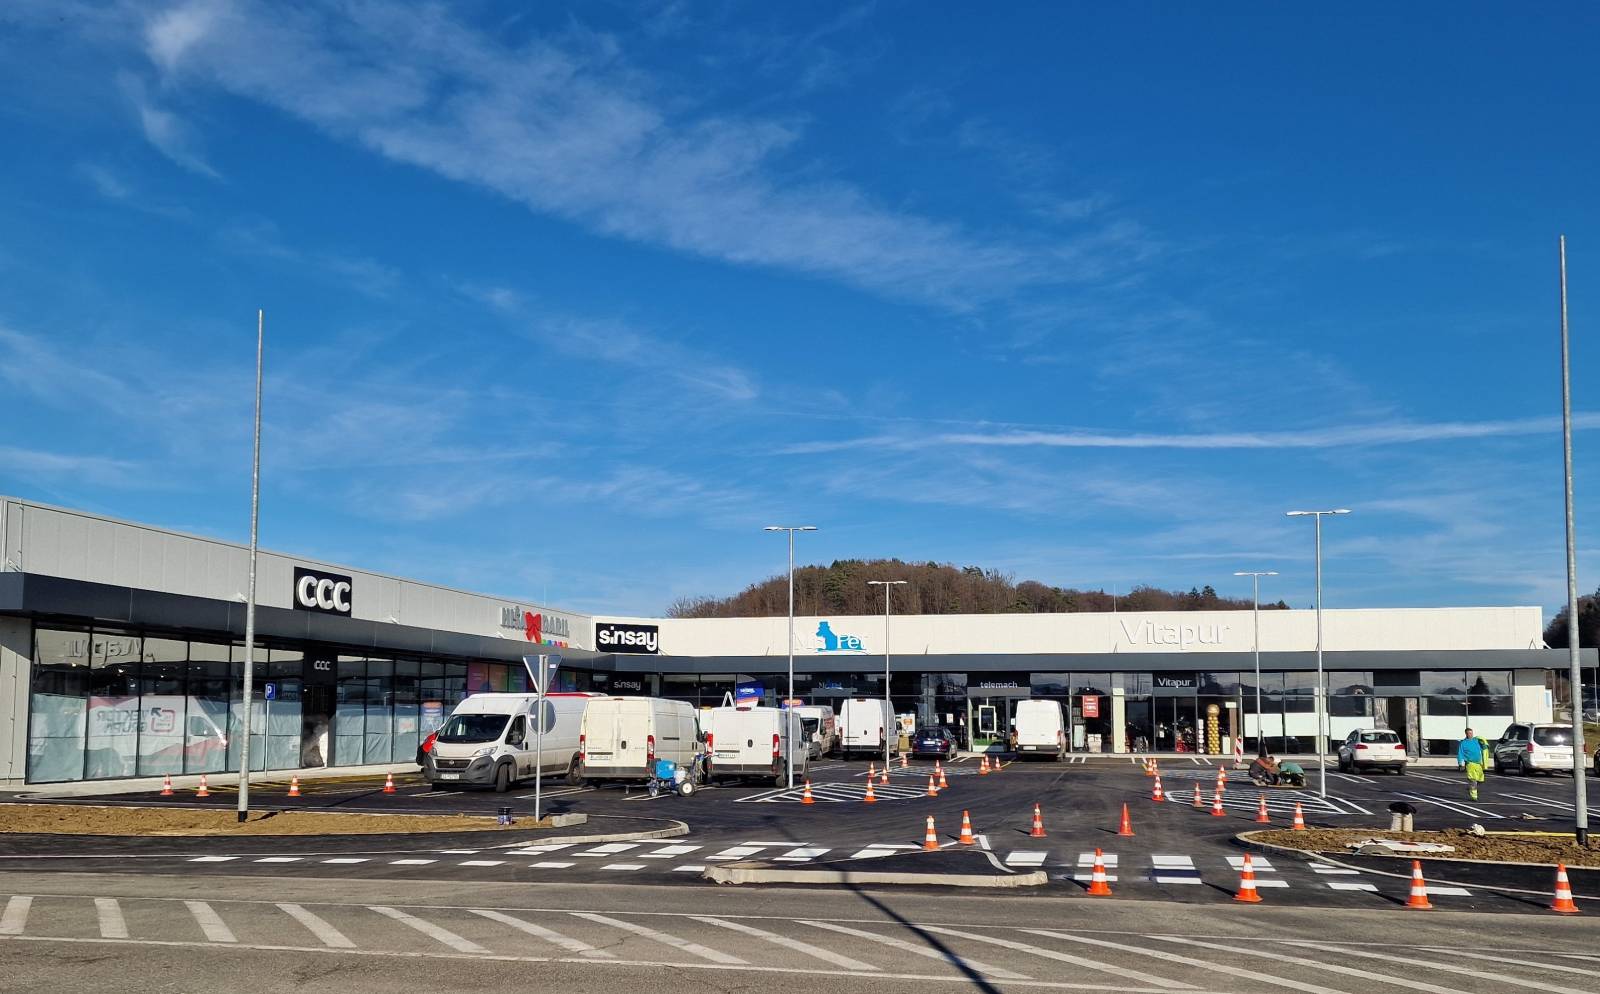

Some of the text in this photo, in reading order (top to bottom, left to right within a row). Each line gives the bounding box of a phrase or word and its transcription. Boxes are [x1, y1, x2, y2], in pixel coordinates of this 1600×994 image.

[297, 575, 351, 613] CCC
[598, 625, 658, 652] sinsay
[1119, 617, 1231, 651] Vitapur
[313, 659, 331, 671] CCC
[613, 679, 642, 691] sinsay
[979, 680, 1018, 690] telemach
[1157, 677, 1193, 689] Vitapur
